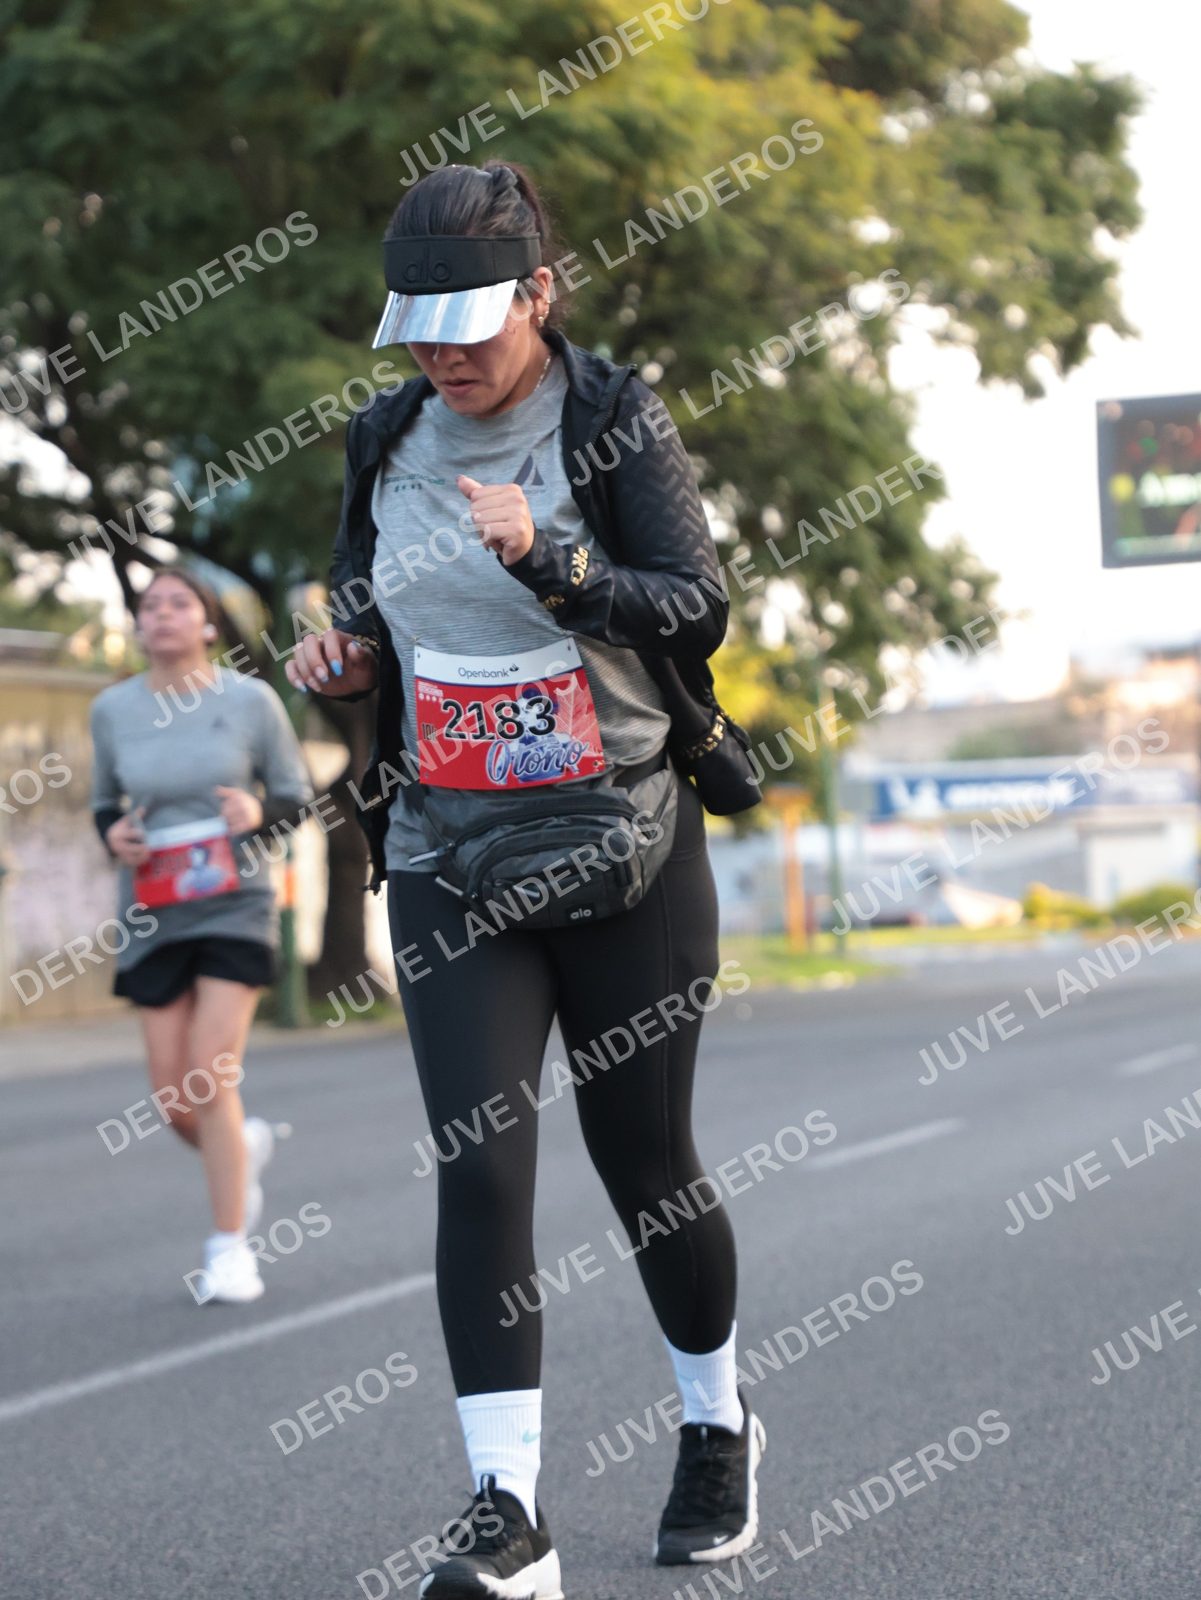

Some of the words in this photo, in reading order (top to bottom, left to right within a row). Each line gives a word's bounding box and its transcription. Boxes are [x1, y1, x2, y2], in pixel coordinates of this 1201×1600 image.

[402, 246, 453, 284] alo
[458, 667, 510, 680] Openbank
[442, 696, 556, 740] 2183
[570, 908, 592, 919] alo
